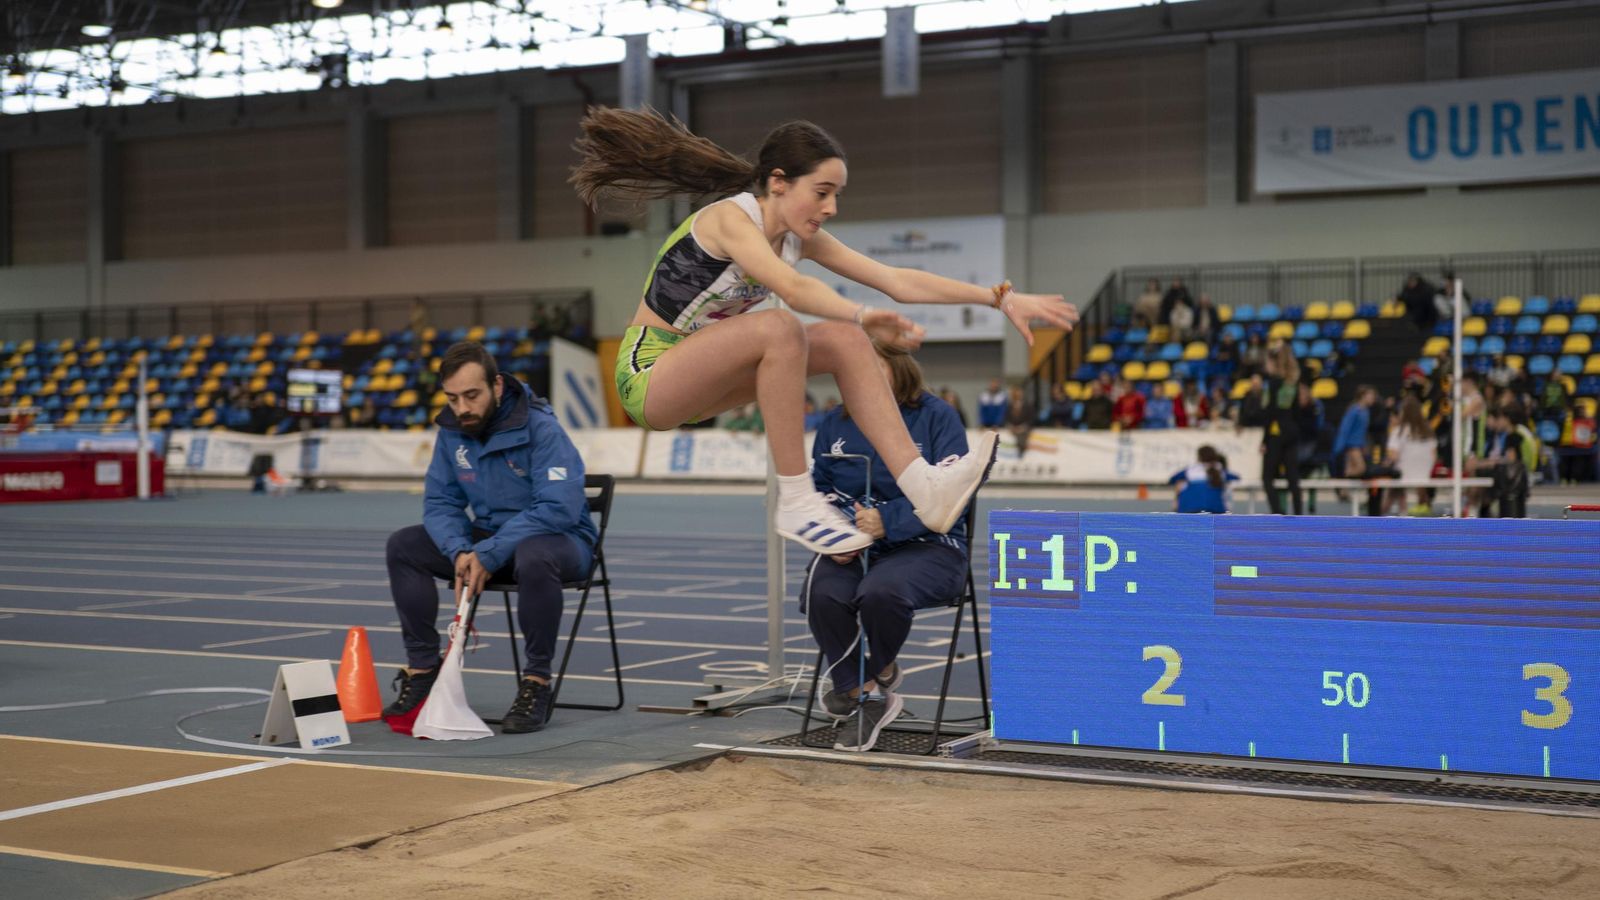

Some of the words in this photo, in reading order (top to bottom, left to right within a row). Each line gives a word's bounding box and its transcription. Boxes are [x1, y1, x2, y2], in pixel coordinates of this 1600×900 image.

[1407, 95, 1600, 162] OUREN
[1141, 644, 1186, 707] 2
[1321, 671, 1371, 708] 50
[1520, 663, 1573, 730] 3
